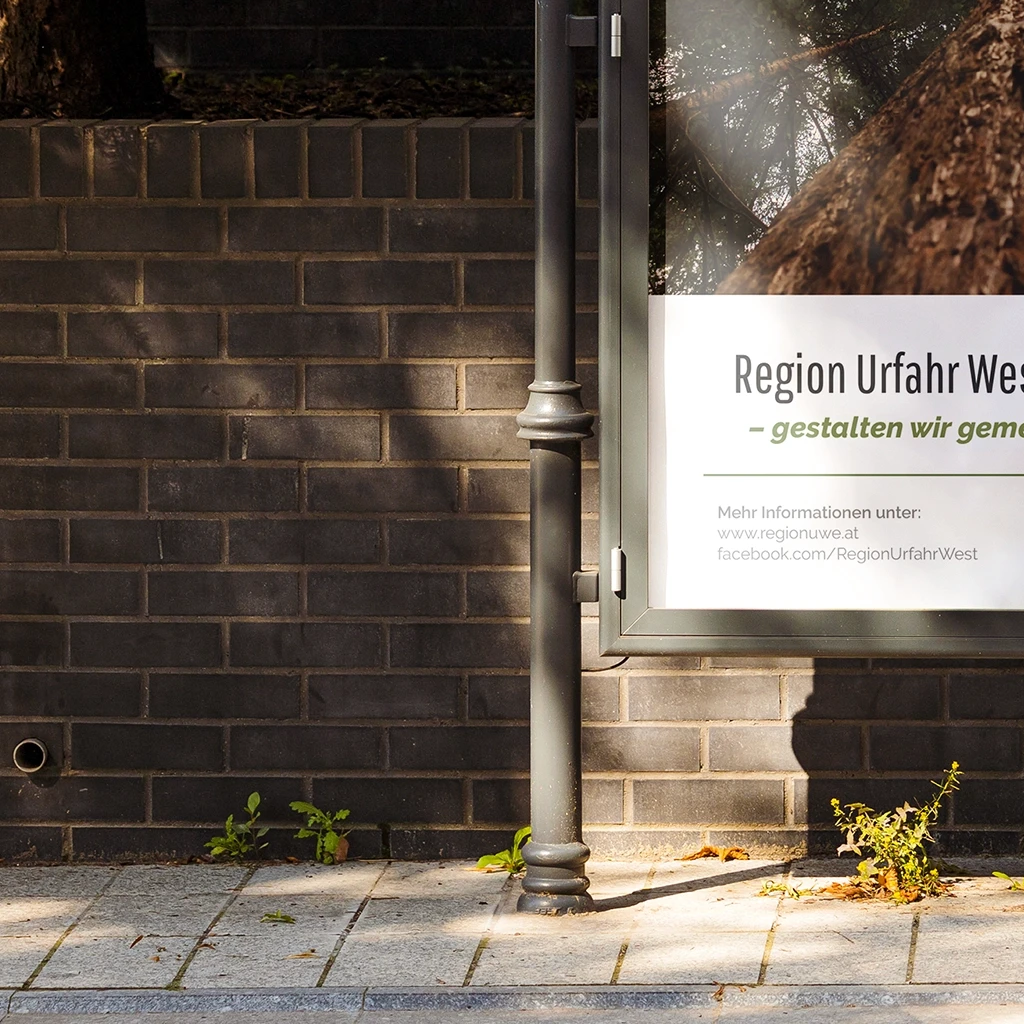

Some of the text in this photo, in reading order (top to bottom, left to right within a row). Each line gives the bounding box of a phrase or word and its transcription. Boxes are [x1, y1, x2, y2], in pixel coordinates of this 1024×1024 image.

[735, 352, 845, 404] Region
[857, 351, 959, 394] Urfahr
[770, 416, 903, 444] gestalten
[910, 416, 952, 438] wir
[718, 506, 922, 519] Mehr Informationen unter:
[717, 526, 859, 543] www.regionuwe.at
[717, 546, 978, 564] facebook.com/RegionUrfahrWest
